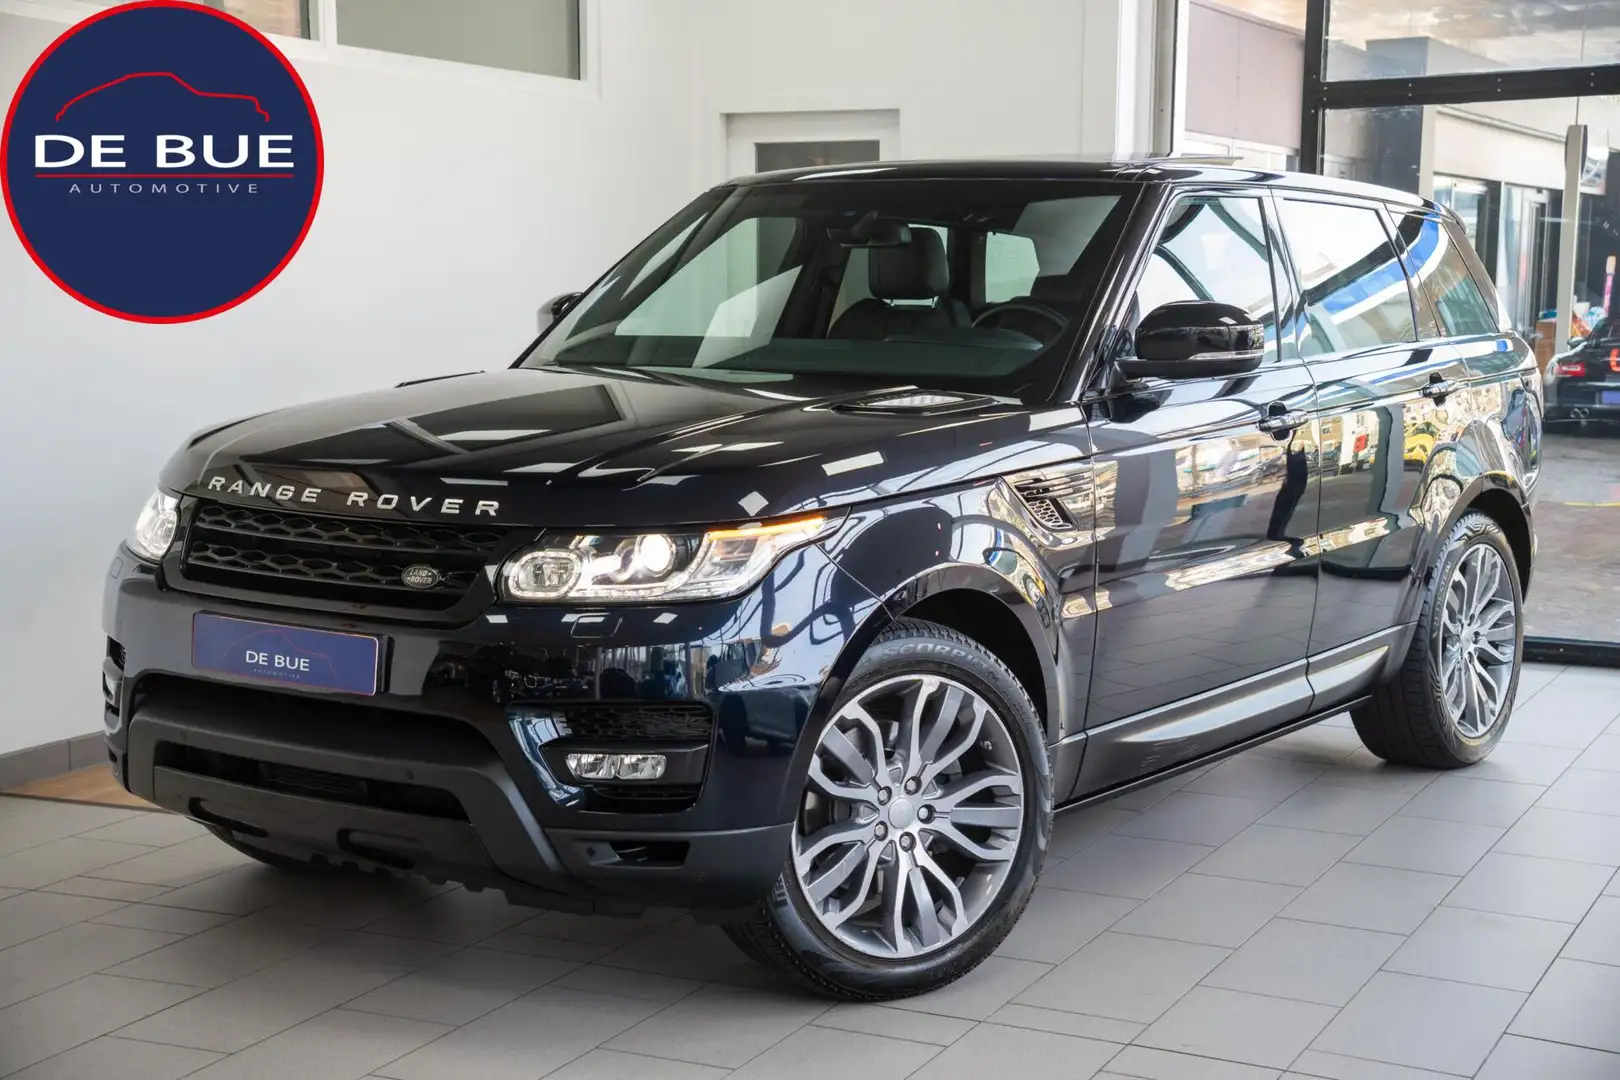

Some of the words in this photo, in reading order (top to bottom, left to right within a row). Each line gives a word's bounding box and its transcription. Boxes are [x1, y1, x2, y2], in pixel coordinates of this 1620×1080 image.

[207, 475, 322, 503] RANGE
[346, 491, 500, 517] ROVER
[245, 650, 269, 666] DE
[274, 654, 310, 671] BUE
